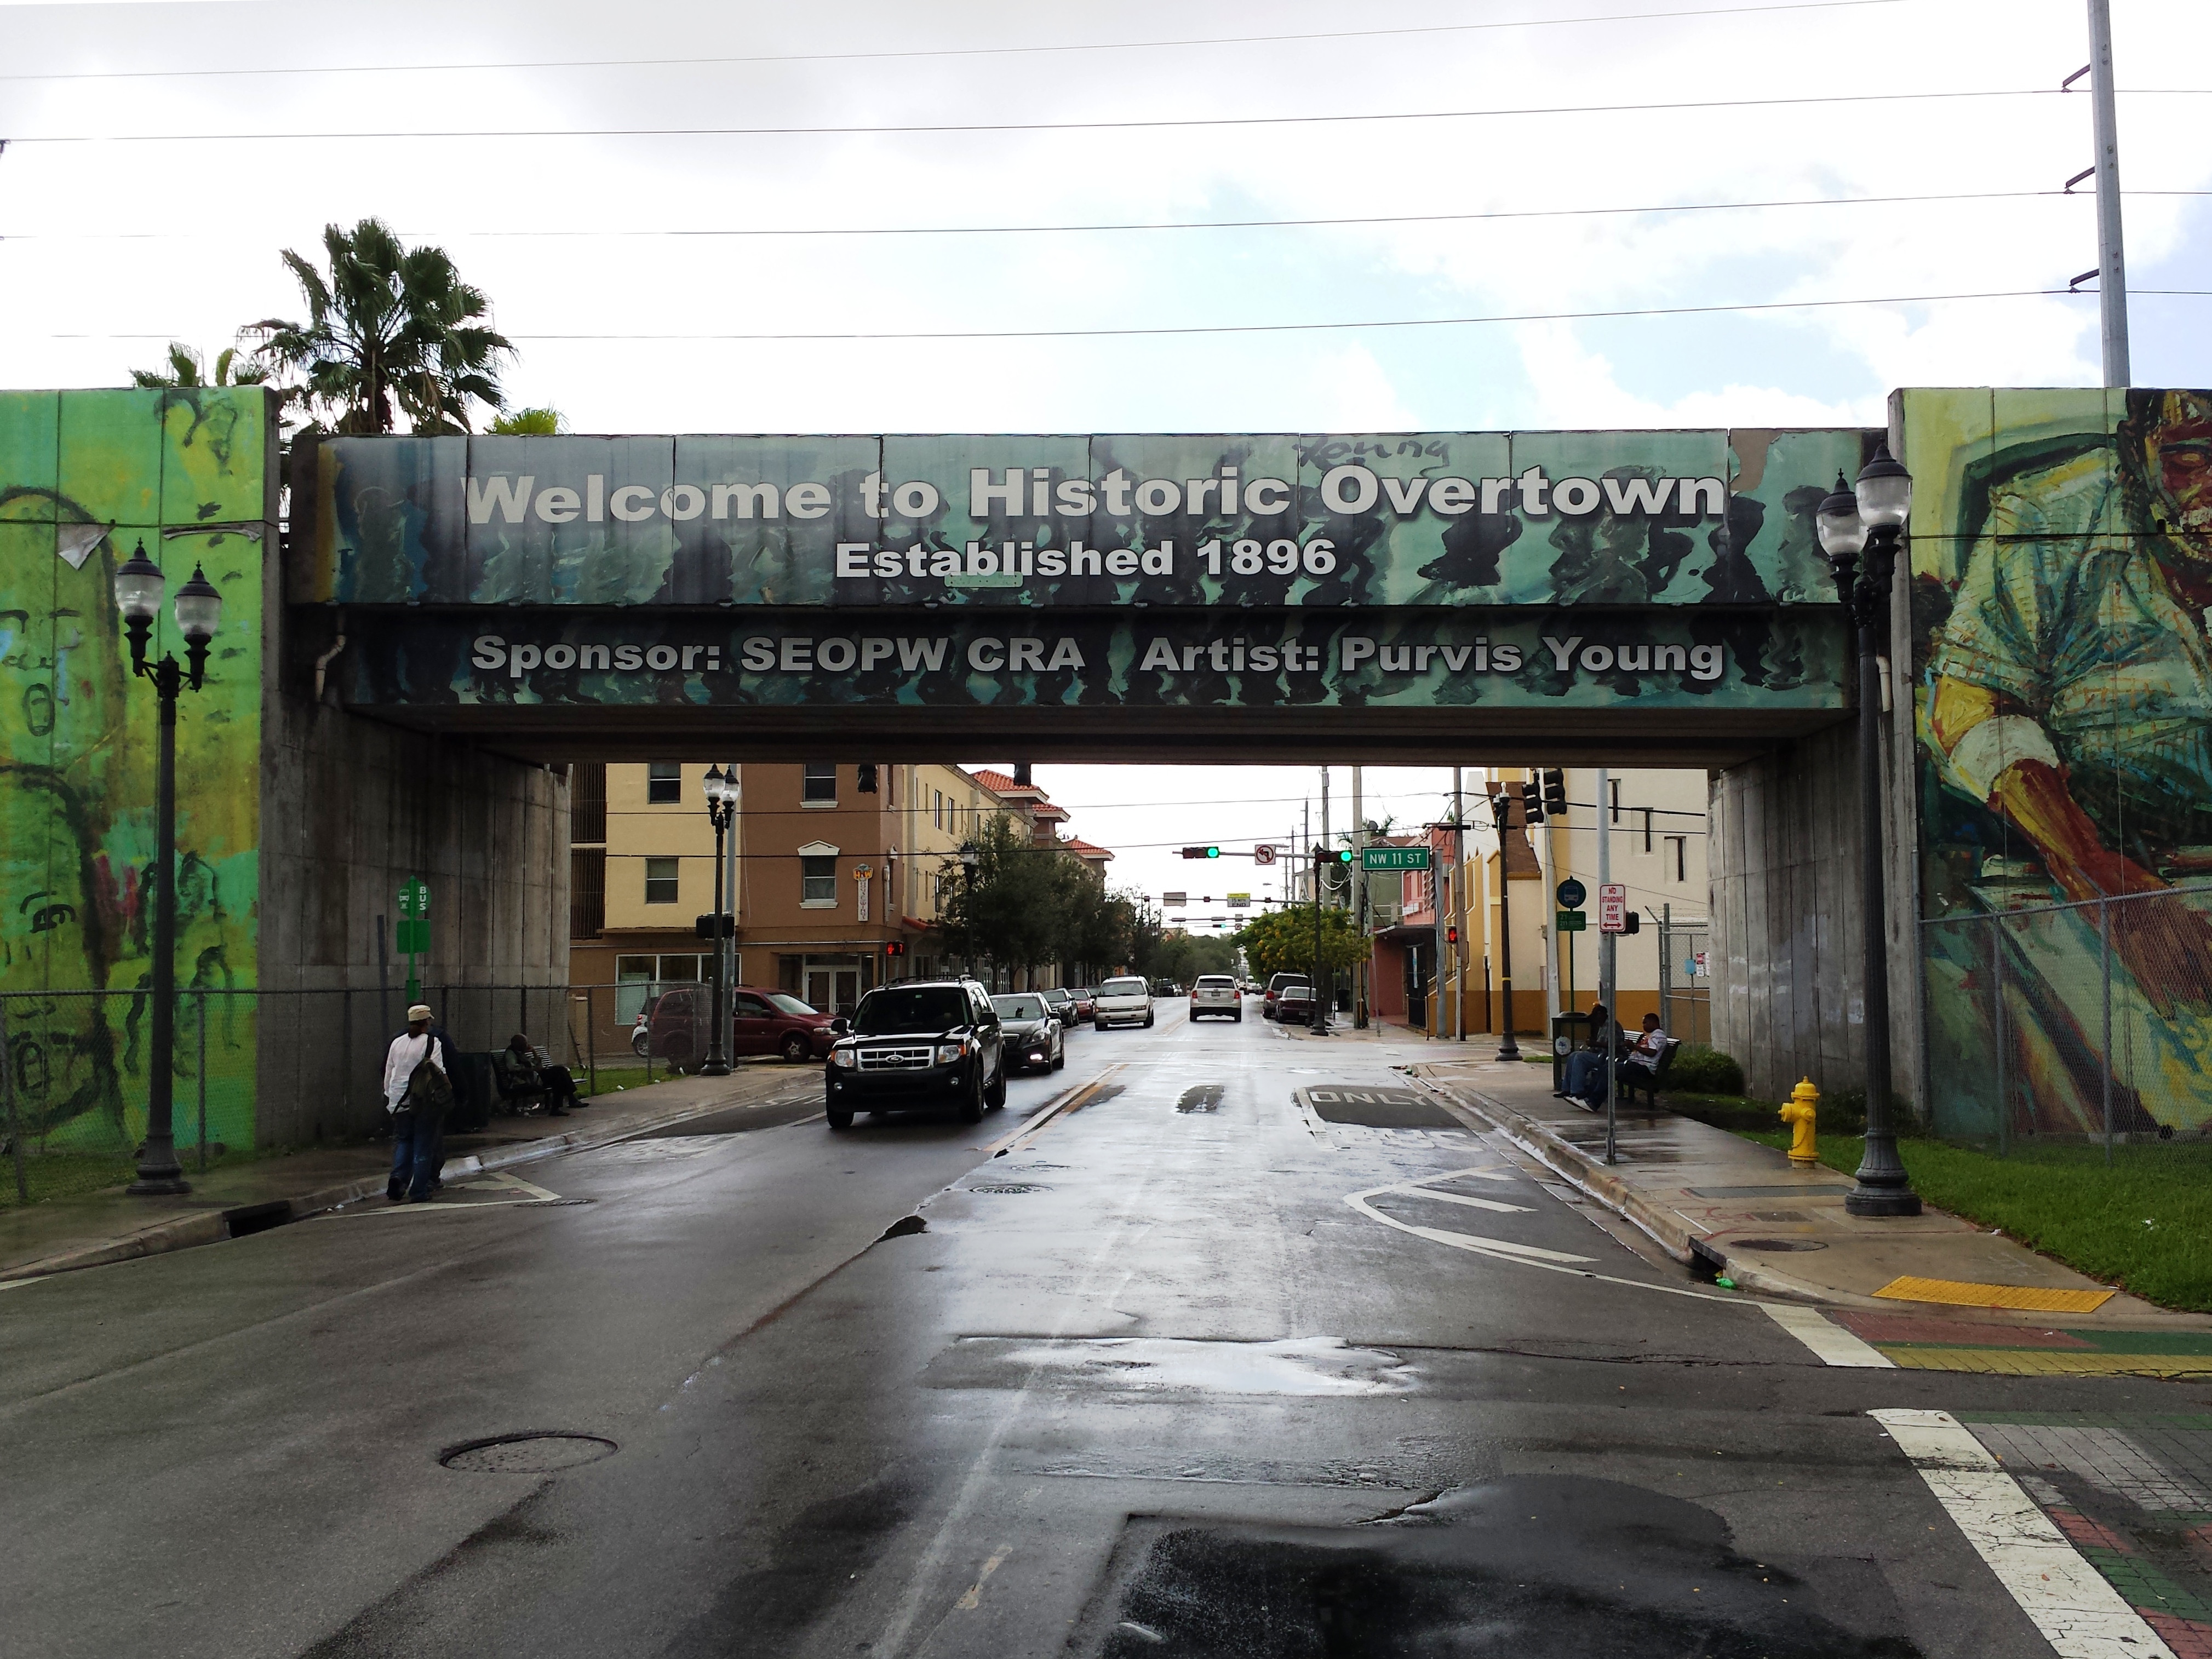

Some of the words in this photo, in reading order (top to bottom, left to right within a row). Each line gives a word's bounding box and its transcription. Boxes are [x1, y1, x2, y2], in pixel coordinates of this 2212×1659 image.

[461, 474, 832, 524] Welcome
[859, 470, 939, 520] to
[969, 466, 1290, 517] Historic
[1320, 464, 1725, 515] Overtown
[836, 539, 1174, 578] Established
[1197, 539, 1337, 576] 1896
[471, 635, 721, 679] Sponsor:
[741, 636, 948, 673] SEOPW
[967, 636, 1085, 672] CRA
[1139, 636, 1319, 672] Artist:
[1341, 636, 1522, 672] Purvis
[1541, 636, 1723, 680] Young
[1369, 853, 1386, 864] NW
[1392, 853, 1401, 865] 11
[1407, 853, 1421, 864] ST
[1309, 1091, 1428, 1106] ONLY
